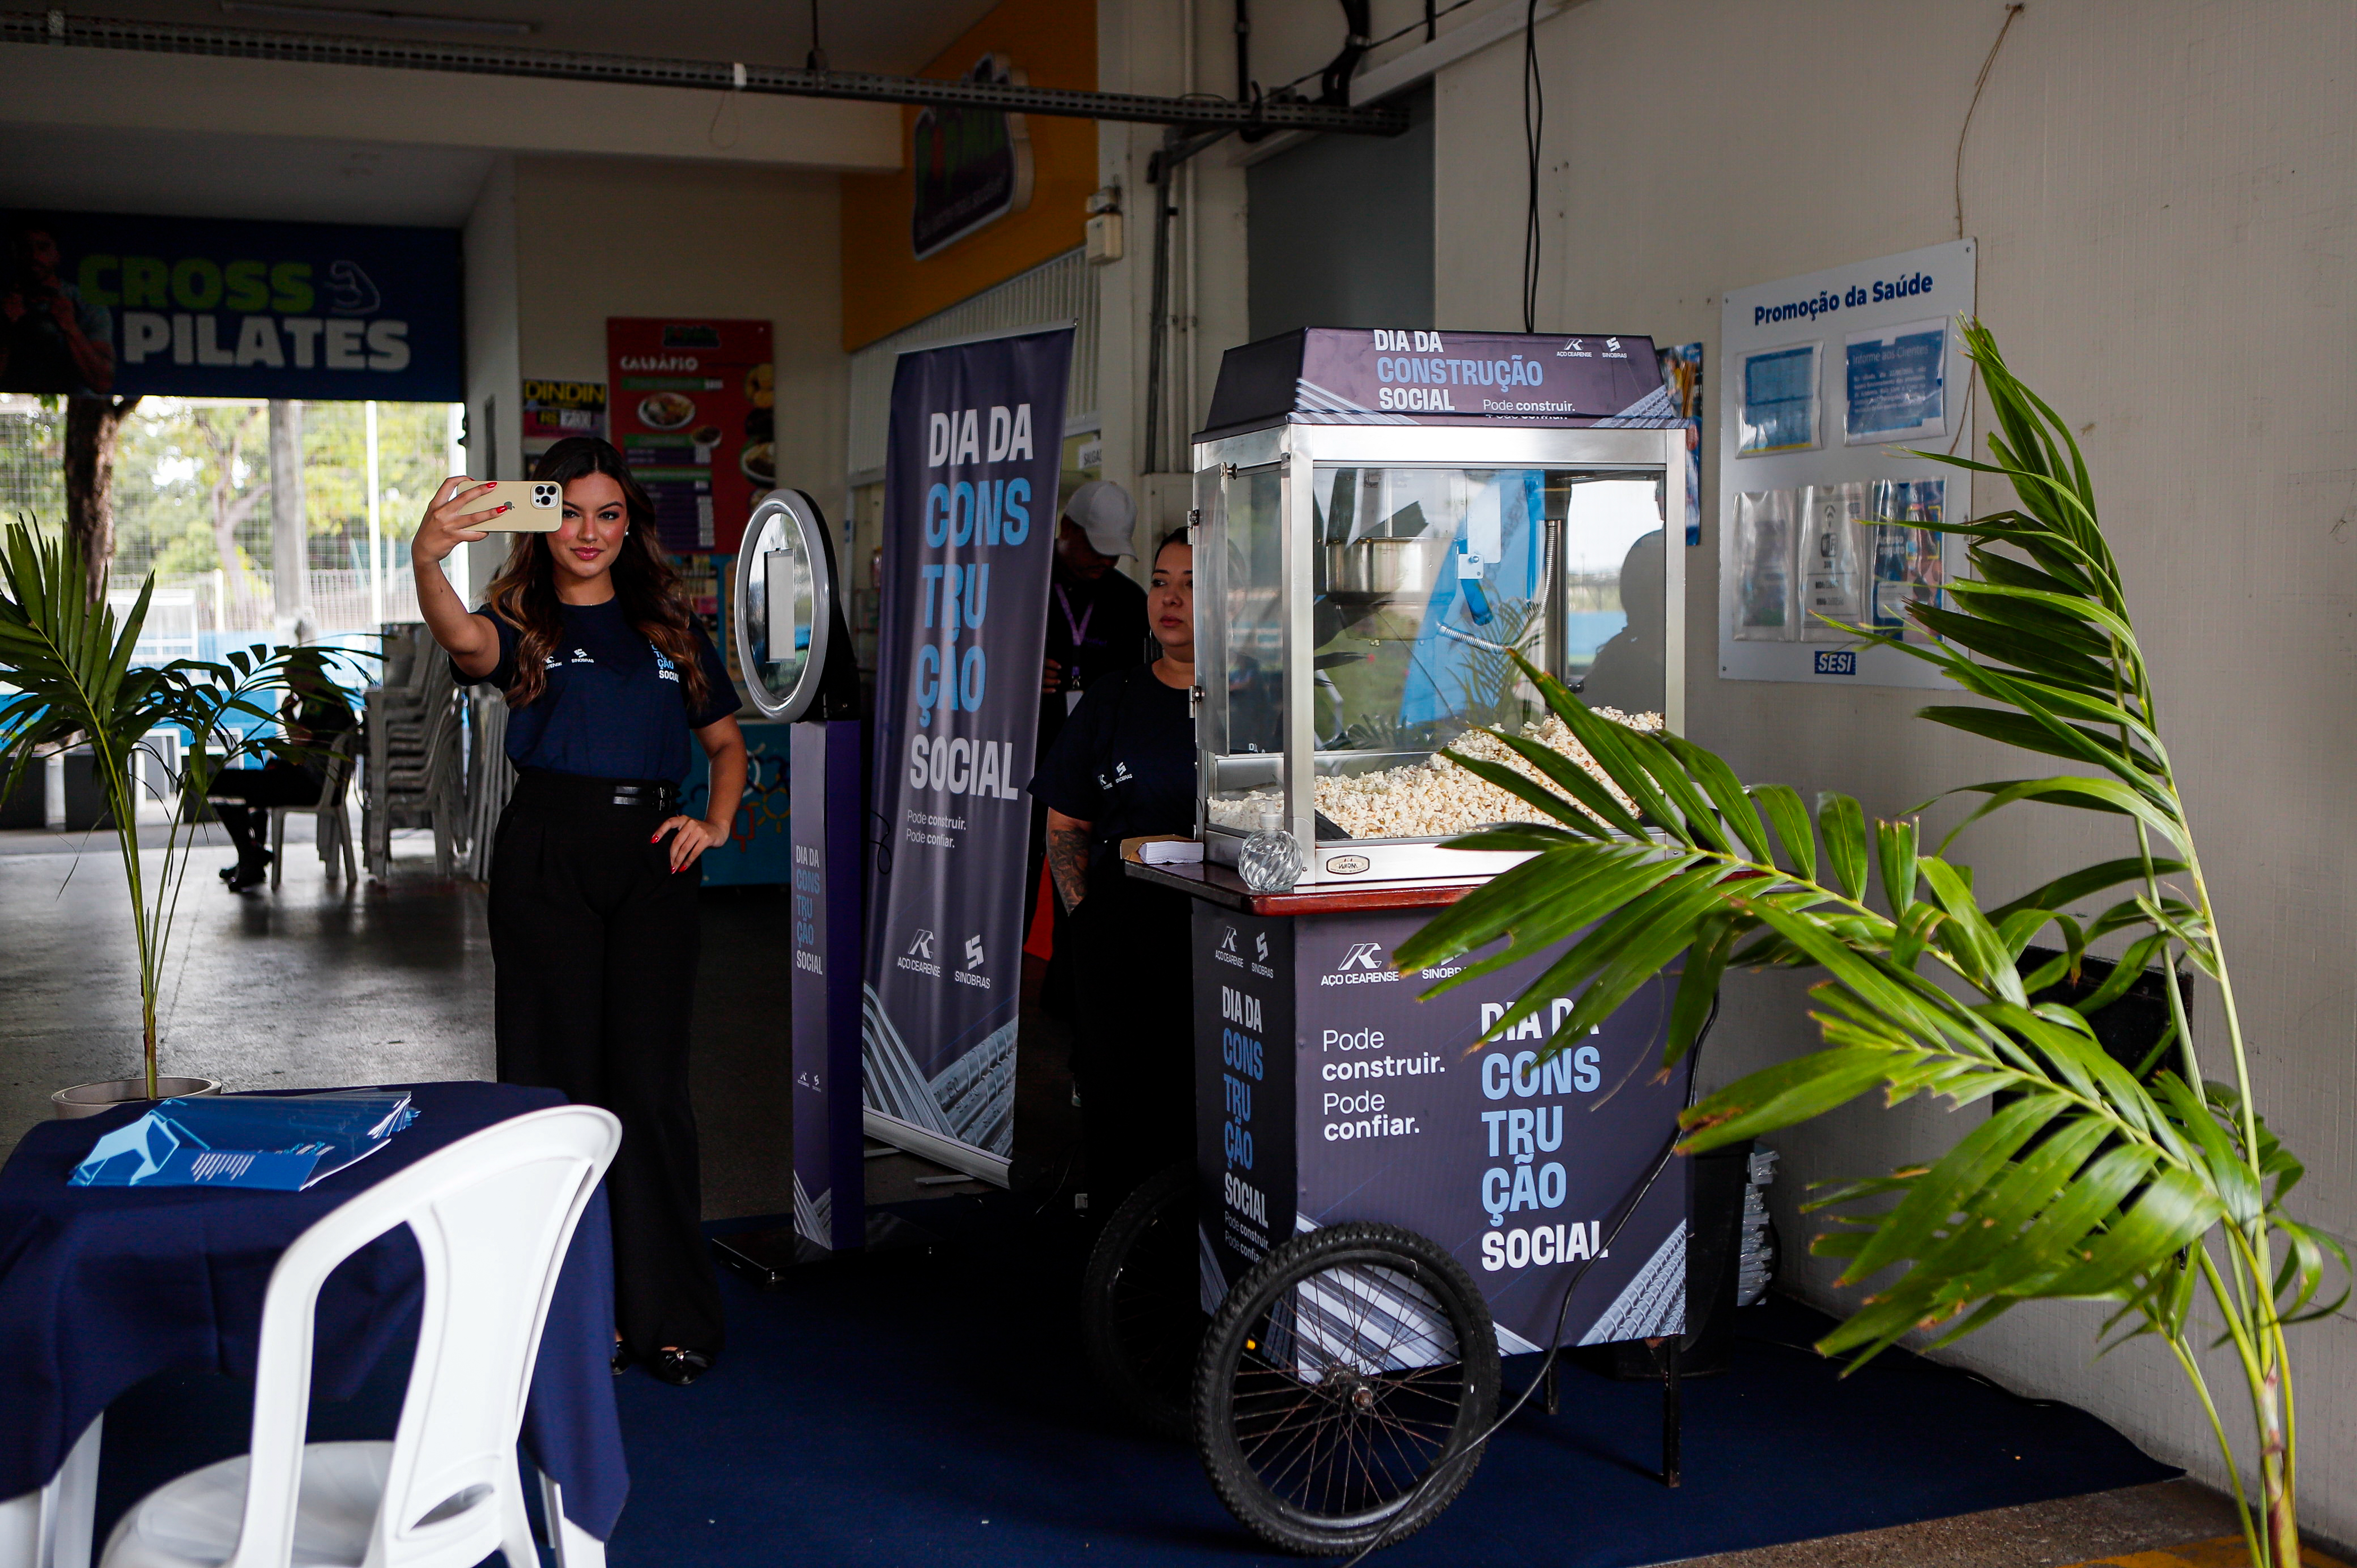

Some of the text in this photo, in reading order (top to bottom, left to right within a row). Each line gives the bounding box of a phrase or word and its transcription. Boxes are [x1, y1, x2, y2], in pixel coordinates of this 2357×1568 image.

[79, 254, 314, 313] CROSS
[1755, 272, 1934, 326] Promoção da Saúde
[124, 312, 411, 372] PILATES
[1374, 329, 1444, 353] DIA DA
[1377, 354, 1544, 393] CONSTRUÇÃO
[1853, 353, 1880, 365] Informe
[1882, 352, 1895, 360] aos
[525, 381, 606, 404] DINDIN
[1379, 387, 1455, 411] SOCIAL
[1483, 399, 1576, 412] Pode construir.
[929, 403, 1033, 468] DIA DA
[925, 477, 1031, 548] CONS
[922, 563, 989, 629] TRU
[659, 670, 679, 684] SOCIAL
[915, 627, 986, 728] ÇÃO
[1818, 654, 1852, 672] SESI
[910, 734, 1019, 800] SOCIAL
[907, 809, 966, 830] Pode construir.
[906, 828, 955, 848] Pode confiar.
[796, 845, 820, 868] DIA DA
[797, 868, 820, 894] CONS
[797, 895, 813, 919] TRU
[797, 917, 814, 948] ÇÃO
[797, 949, 823, 976] SOCIAL
[897, 956, 941, 977] AÇO CEARENSE
[1252, 962, 1274, 979] SINOBRAS
[1422, 967, 1467, 979] SINOBR
[955, 970, 990, 989] SINOBRAS
[1321, 971, 1400, 986] AÇO CEARENSE
[1222, 985, 1263, 1034] DIA DA
[1551, 997, 1600, 1036] D
[1223, 1027, 1263, 1081] CONS
[1323, 1027, 1385, 1052] Pode
[1322, 1051, 1446, 1081] construir.
[1482, 1045, 1601, 1100] CONS
[1223, 1073, 1251, 1122] TRU
[1324, 1090, 1385, 1116] Pode
[1324, 1113, 1420, 1141] confiar.
[1482, 1106, 1563, 1157] TRU
[1224, 1116, 1253, 1170] ÇÃO
[1225, 1172, 1269, 1230] SOCIAL
[1482, 1153, 1567, 1227] ÇÃO
[1225, 1210, 1270, 1252] Pode construir.
[1482, 1220, 1609, 1272] SOCIAL
[1225, 1230, 1262, 1264] Pode confia
